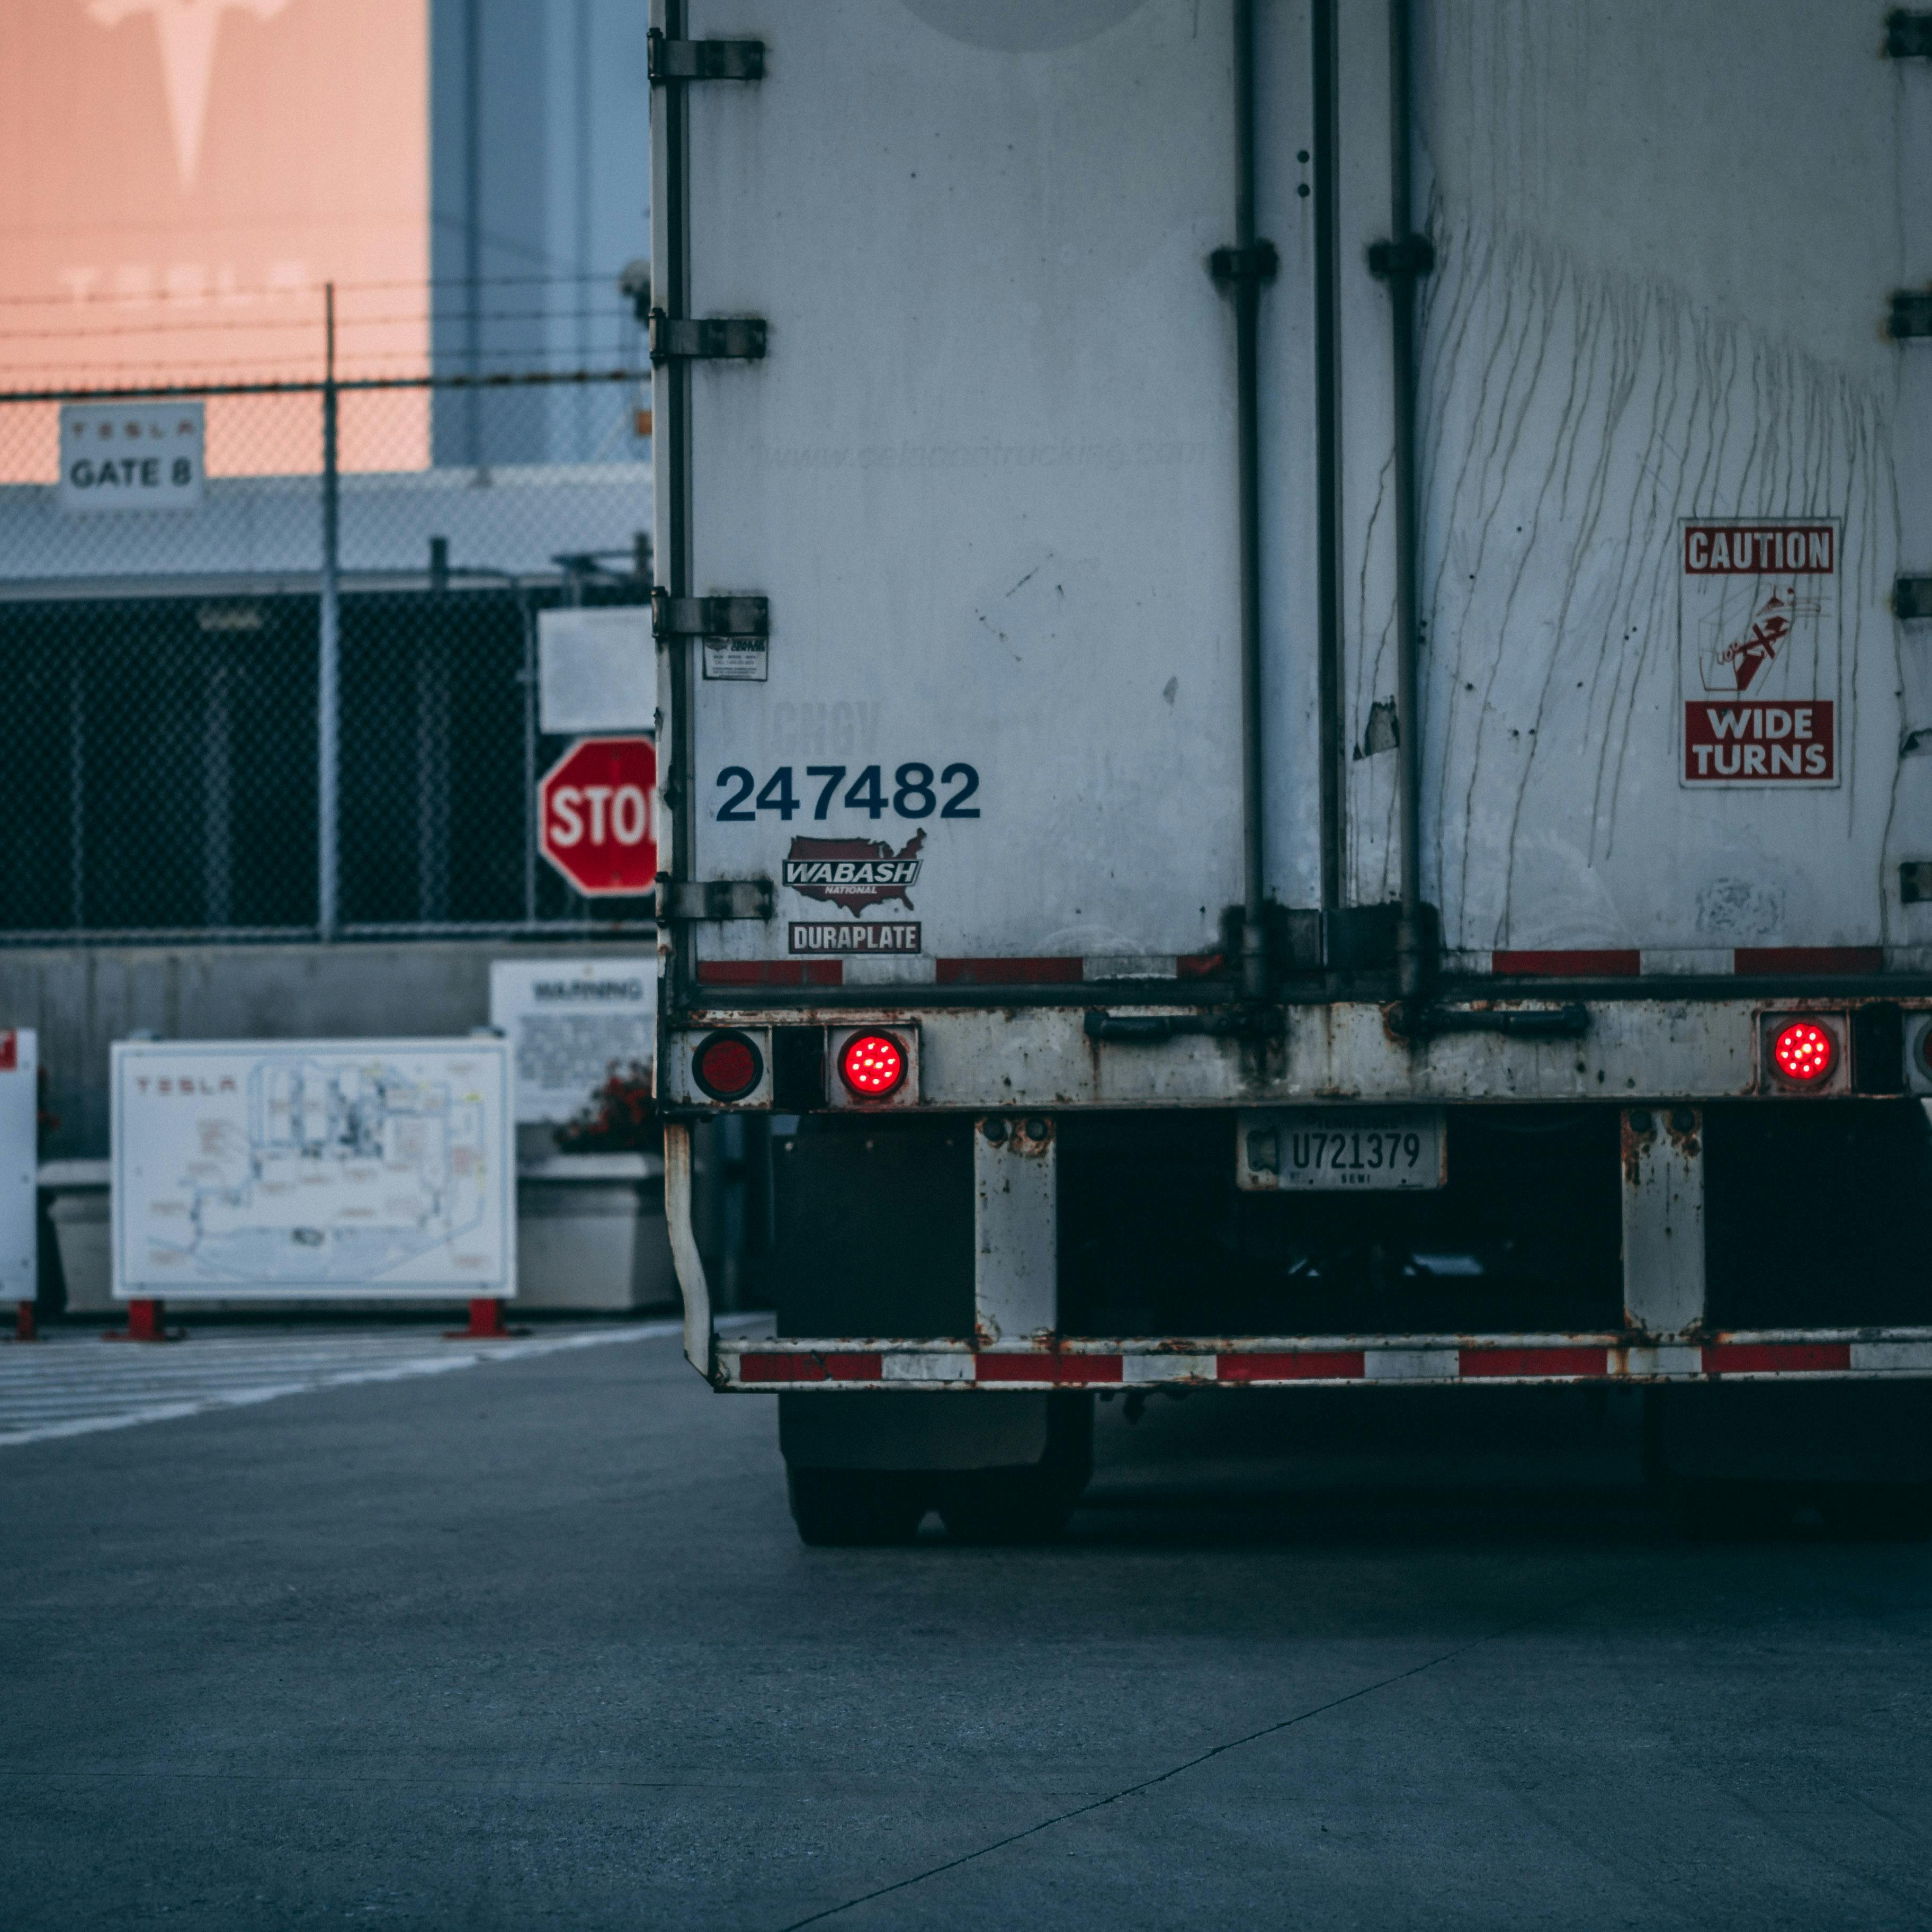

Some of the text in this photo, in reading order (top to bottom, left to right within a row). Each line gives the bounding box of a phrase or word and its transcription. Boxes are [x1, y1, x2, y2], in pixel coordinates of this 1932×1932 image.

[70, 458, 160, 488] GATE
[1688, 532, 1830, 569] CAUTION
[1706, 709, 1813, 739] WIDE
[1692, 744, 1827, 775] TURNS
[716, 762, 981, 822] 247482
[787, 862, 917, 883] WABASH
[824, 885, 878, 895] NATIONAL
[793, 926, 917, 950] DURAPLATE
[1293, 1133, 1420, 1169] U721379
[1341, 1174, 1371, 1184] SEMI
